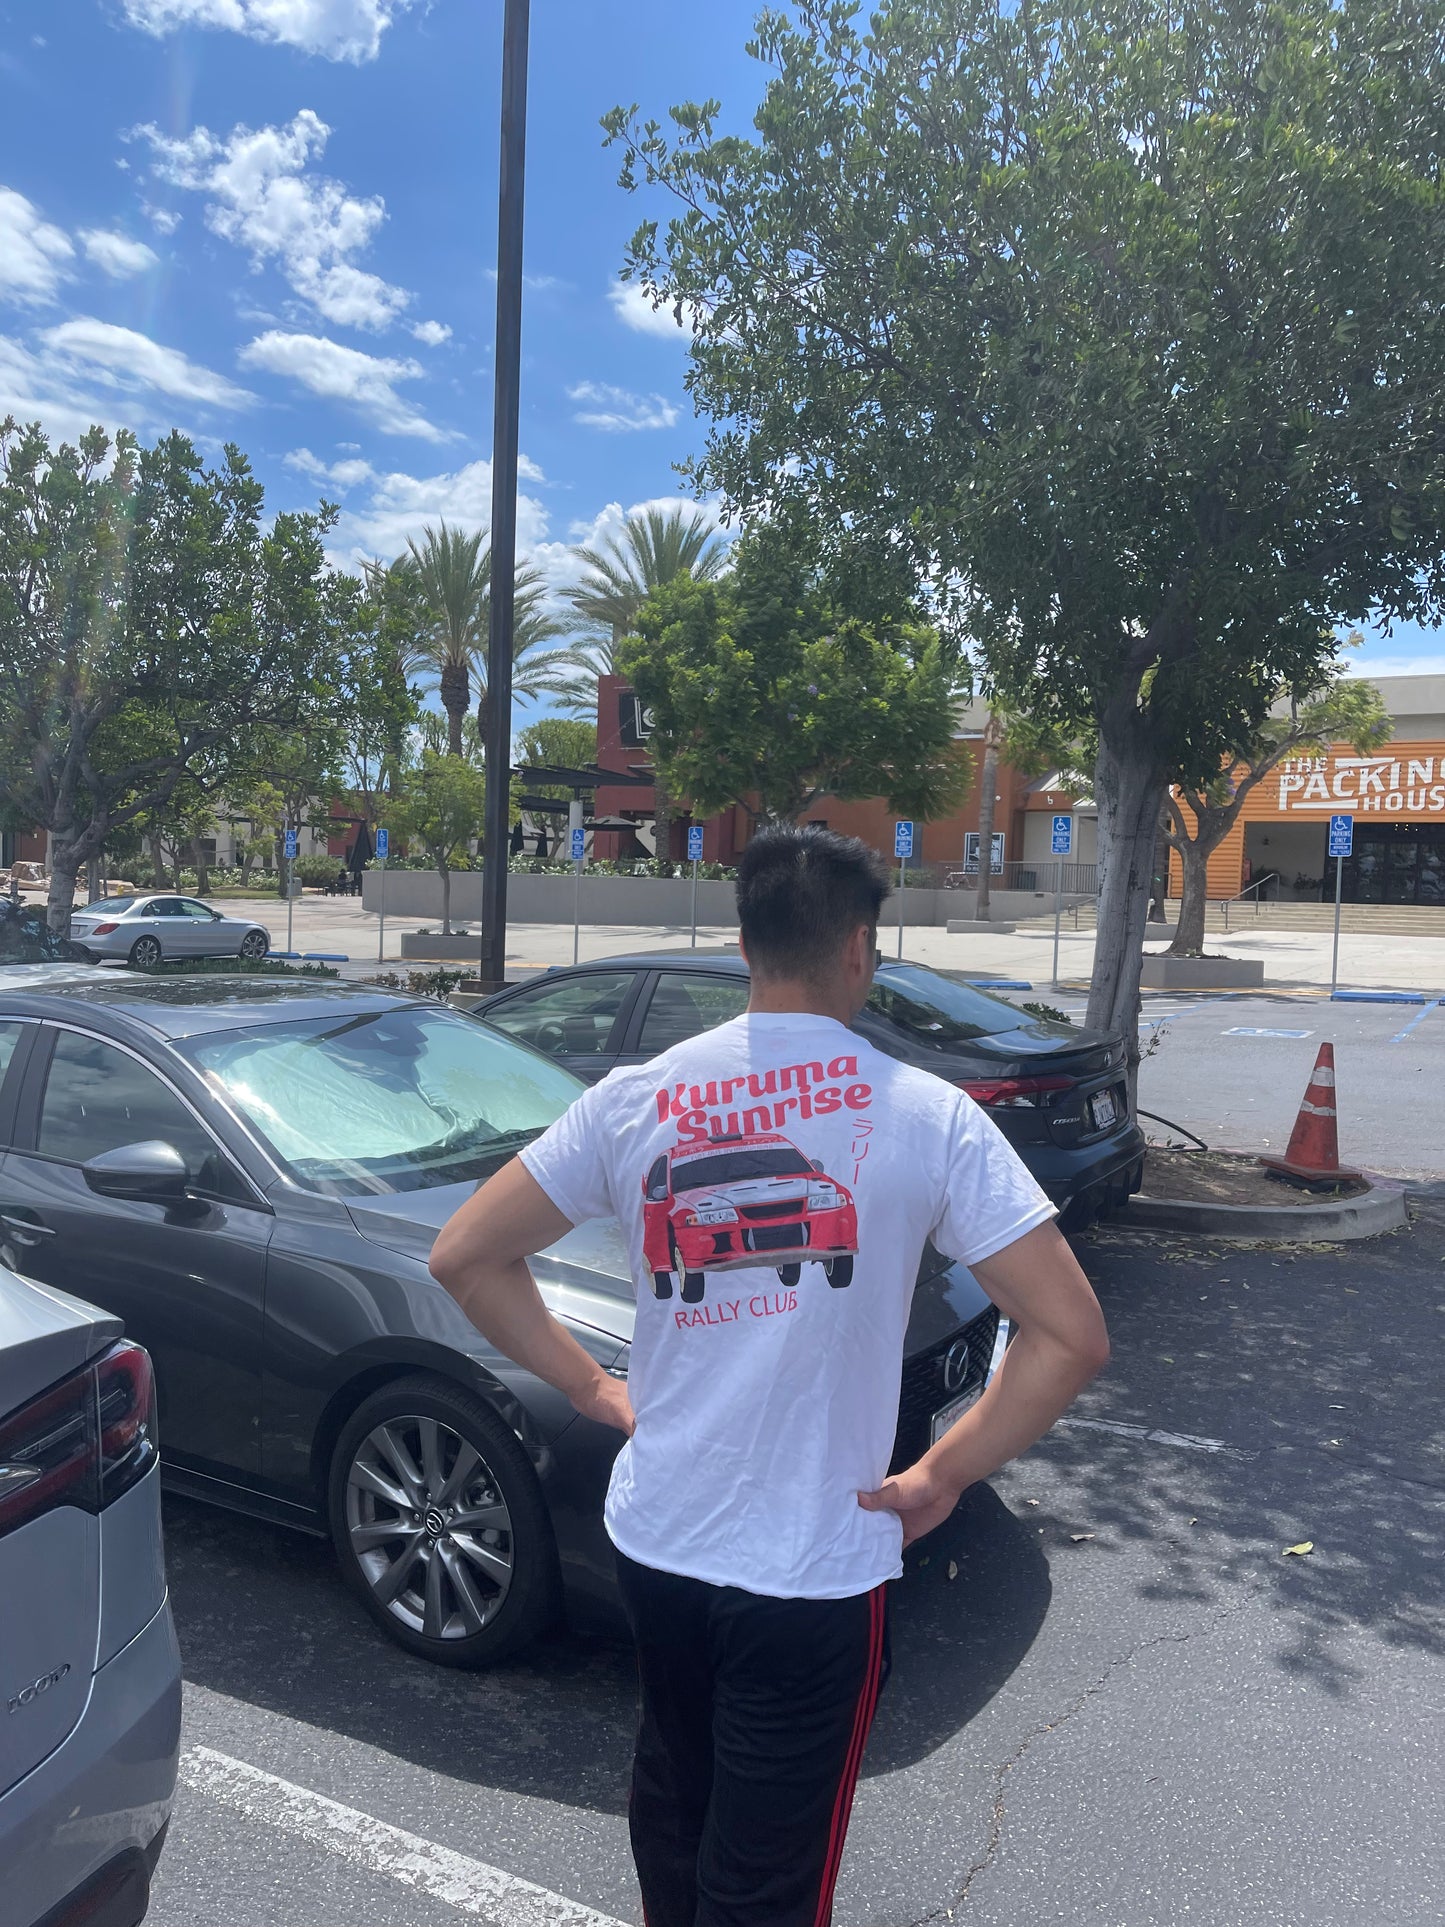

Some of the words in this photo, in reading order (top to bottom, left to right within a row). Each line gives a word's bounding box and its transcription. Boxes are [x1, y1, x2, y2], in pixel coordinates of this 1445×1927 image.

[1278, 757, 1445, 811] PACKIN
[1283, 757, 1329, 773] THE
[656, 1055, 858, 1124] Kuruma
[676, 1083, 873, 1146] Sunrise
[674, 1300, 741, 1330] RALLY
